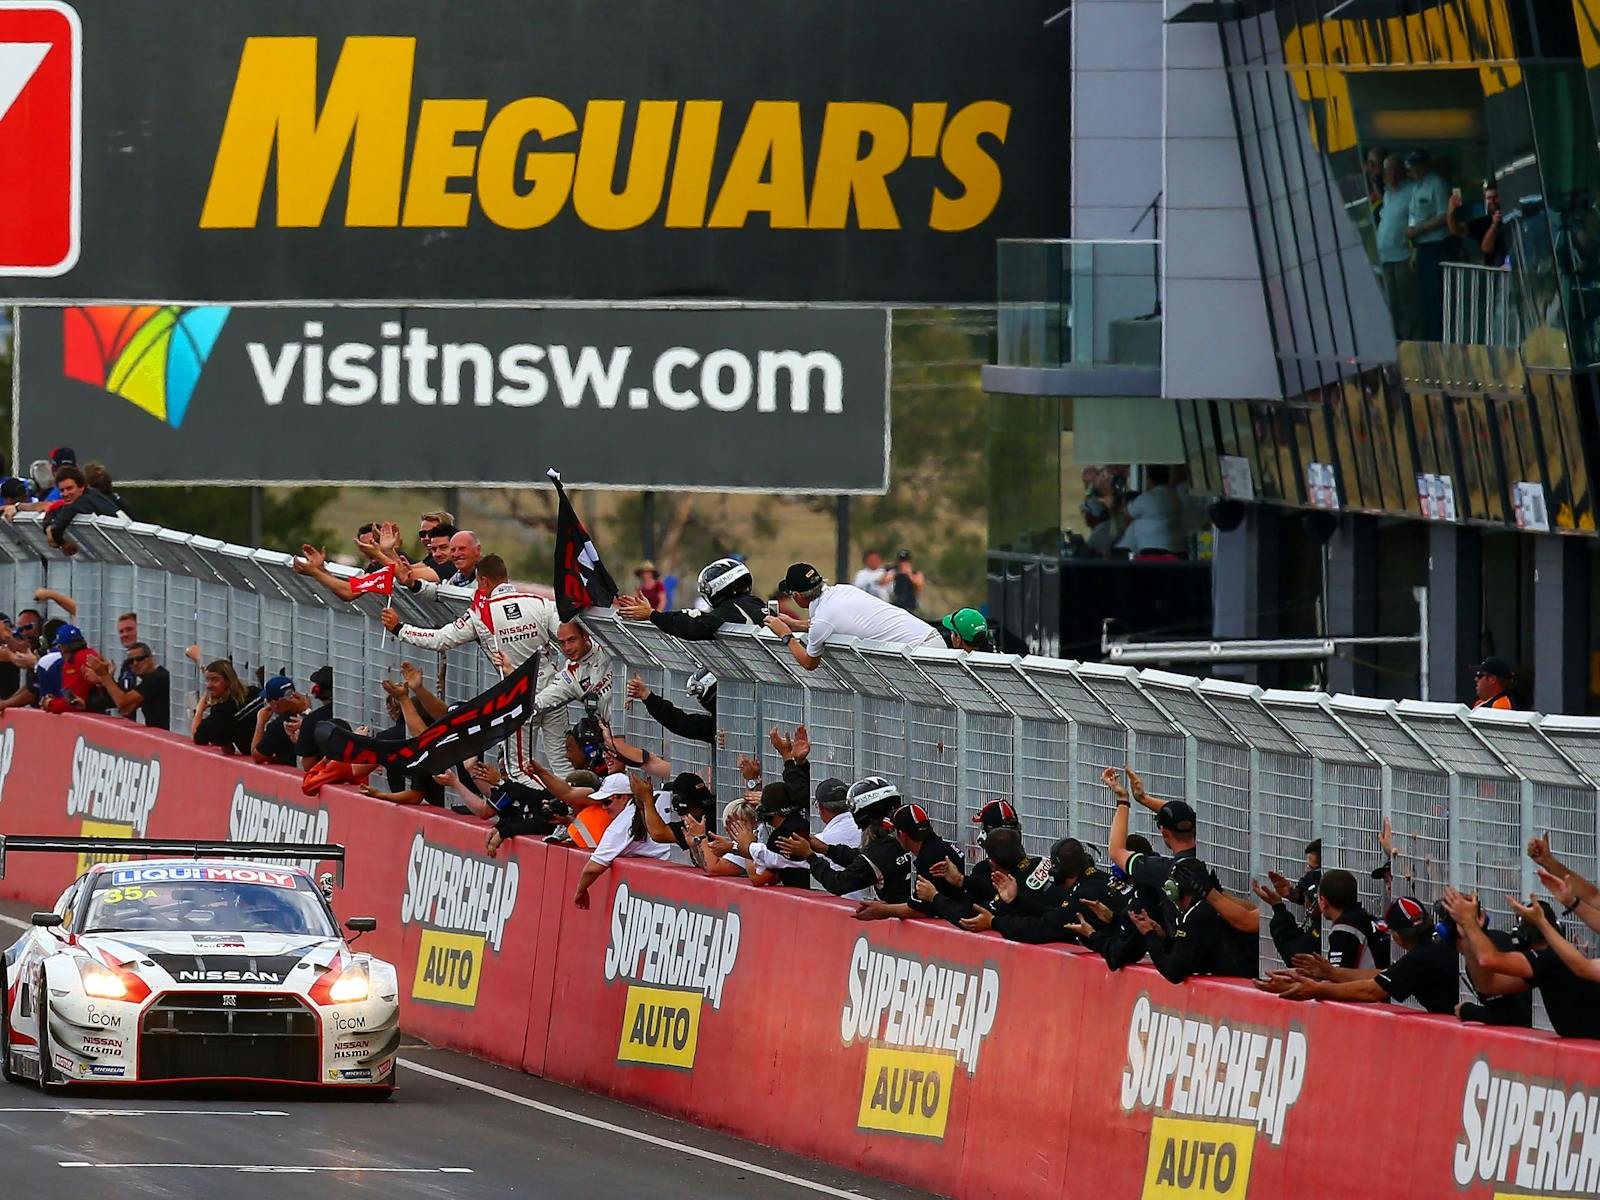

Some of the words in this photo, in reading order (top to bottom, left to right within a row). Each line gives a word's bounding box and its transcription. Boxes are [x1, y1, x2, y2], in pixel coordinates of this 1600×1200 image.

[199, 35, 1012, 231] MEGUIAR'S
[246, 321, 845, 413] visitnsw.com
[404, 629, 434, 638] NISSAN
[499, 622, 537, 636] NISSAN
[66, 735, 161, 839] SUPERCHEAP
[118, 868, 200, 882] LIQUI
[207, 867, 293, 885] MOLY
[401, 833, 520, 952] SUPERCHEAP
[422, 945, 474, 990] AUTO
[604, 883, 741, 1010] SUPERCHEAP
[179, 970, 279, 982] NISSAN
[629, 1003, 690, 1051] AUTO
[841, 936, 1000, 1073] SUPERCHEAP
[83, 1036, 123, 1048] NISSAN
[334, 1041, 369, 1050] NISSAN
[870, 1066, 941, 1119] AUTO
[1121, 996, 1308, 1145] SUPERCHEAP
[1454, 1060, 1600, 1194] SUPERCH
[1156, 1137, 1237, 1194] AUTO
